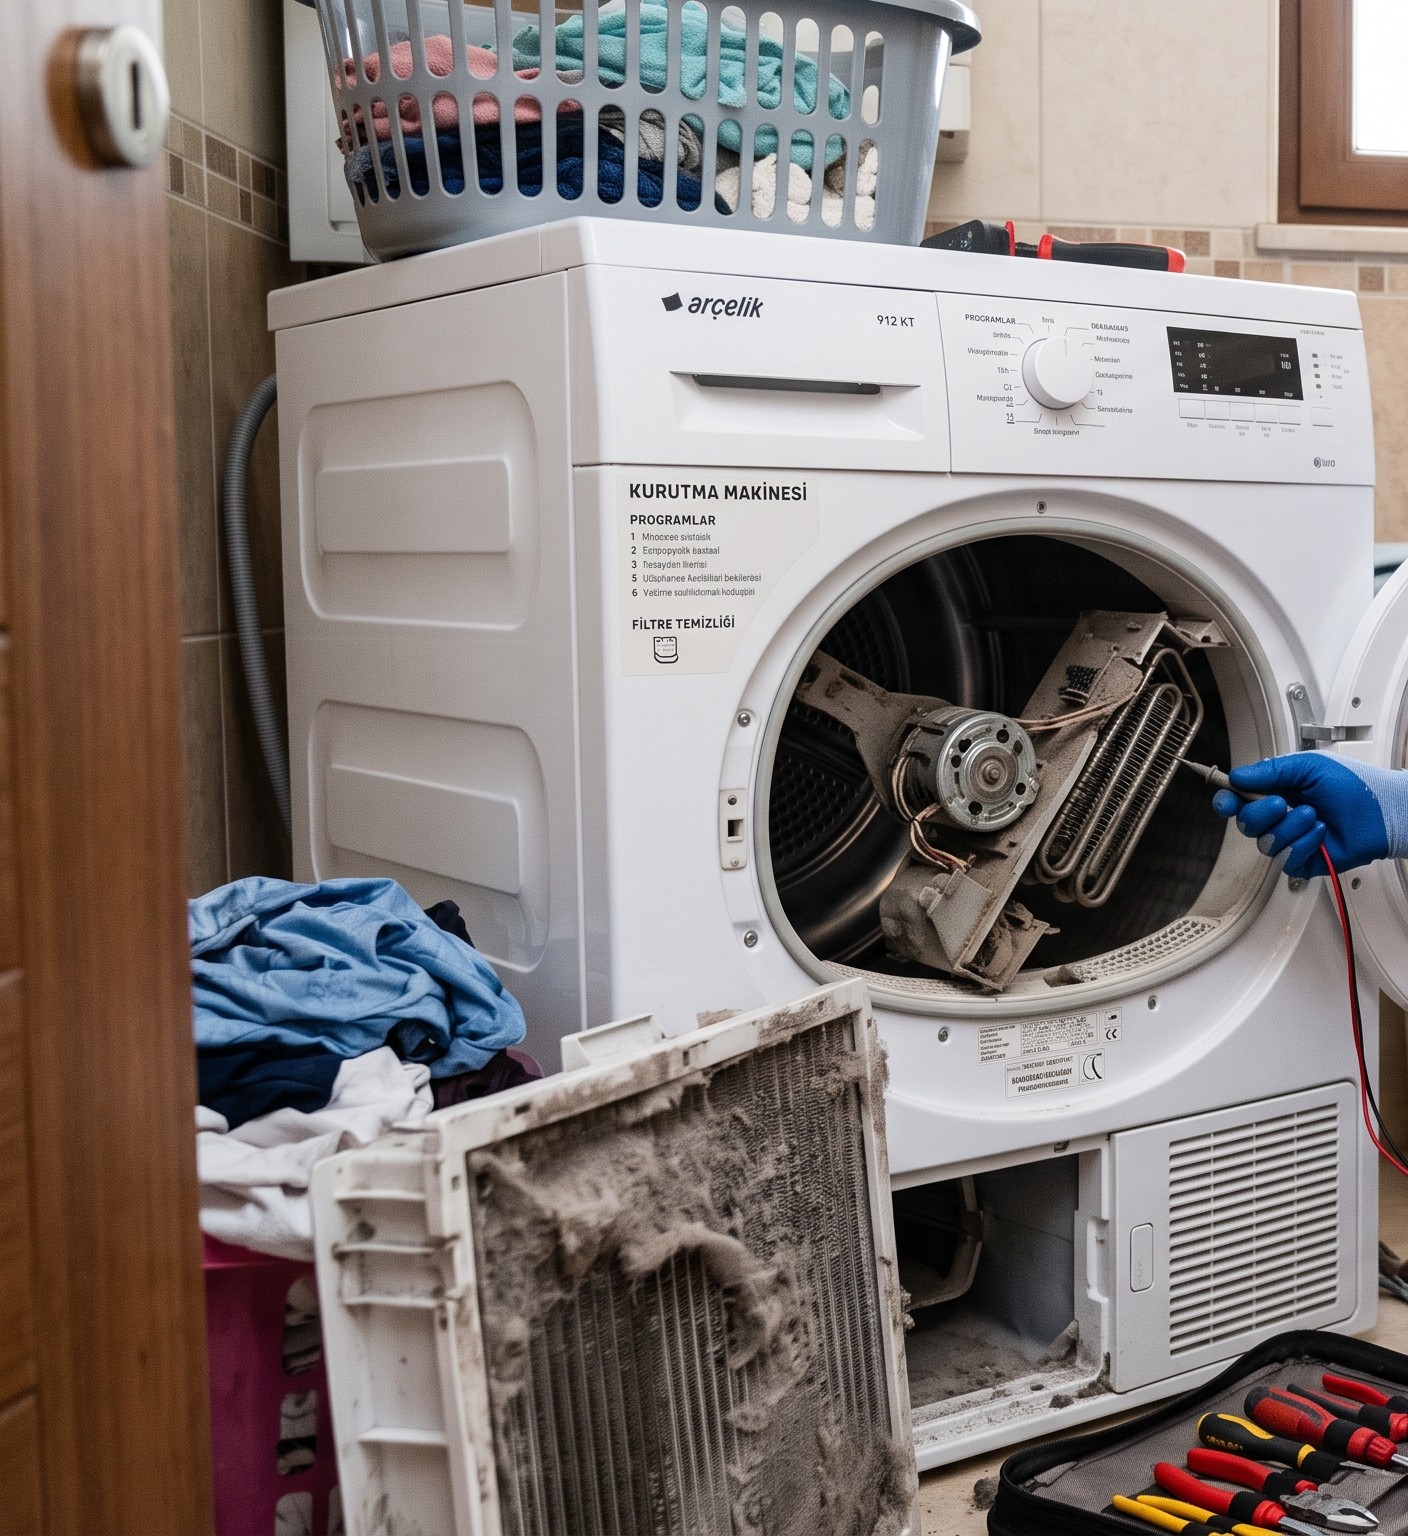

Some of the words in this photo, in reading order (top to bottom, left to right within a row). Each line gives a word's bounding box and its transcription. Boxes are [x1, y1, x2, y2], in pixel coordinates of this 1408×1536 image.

[687, 296, 764, 320] arçelik
[877, 314, 898, 327] 912
[901, 317, 915, 328] KT
[629, 483, 719, 500] KURUTMA
[724, 482, 807, 501] MAKİNESİ
[630, 514, 716, 526] PROGRAMLAR
[631, 532, 635, 541] 1
[631, 546, 637, 555] 2
[631, 560, 637, 569] 3
[632, 574, 638, 582] 5
[632, 588, 638, 597] 6
[632, 616, 673, 630] FİLTRE
[675, 615, 735, 629] TEMİZLİĞİ
